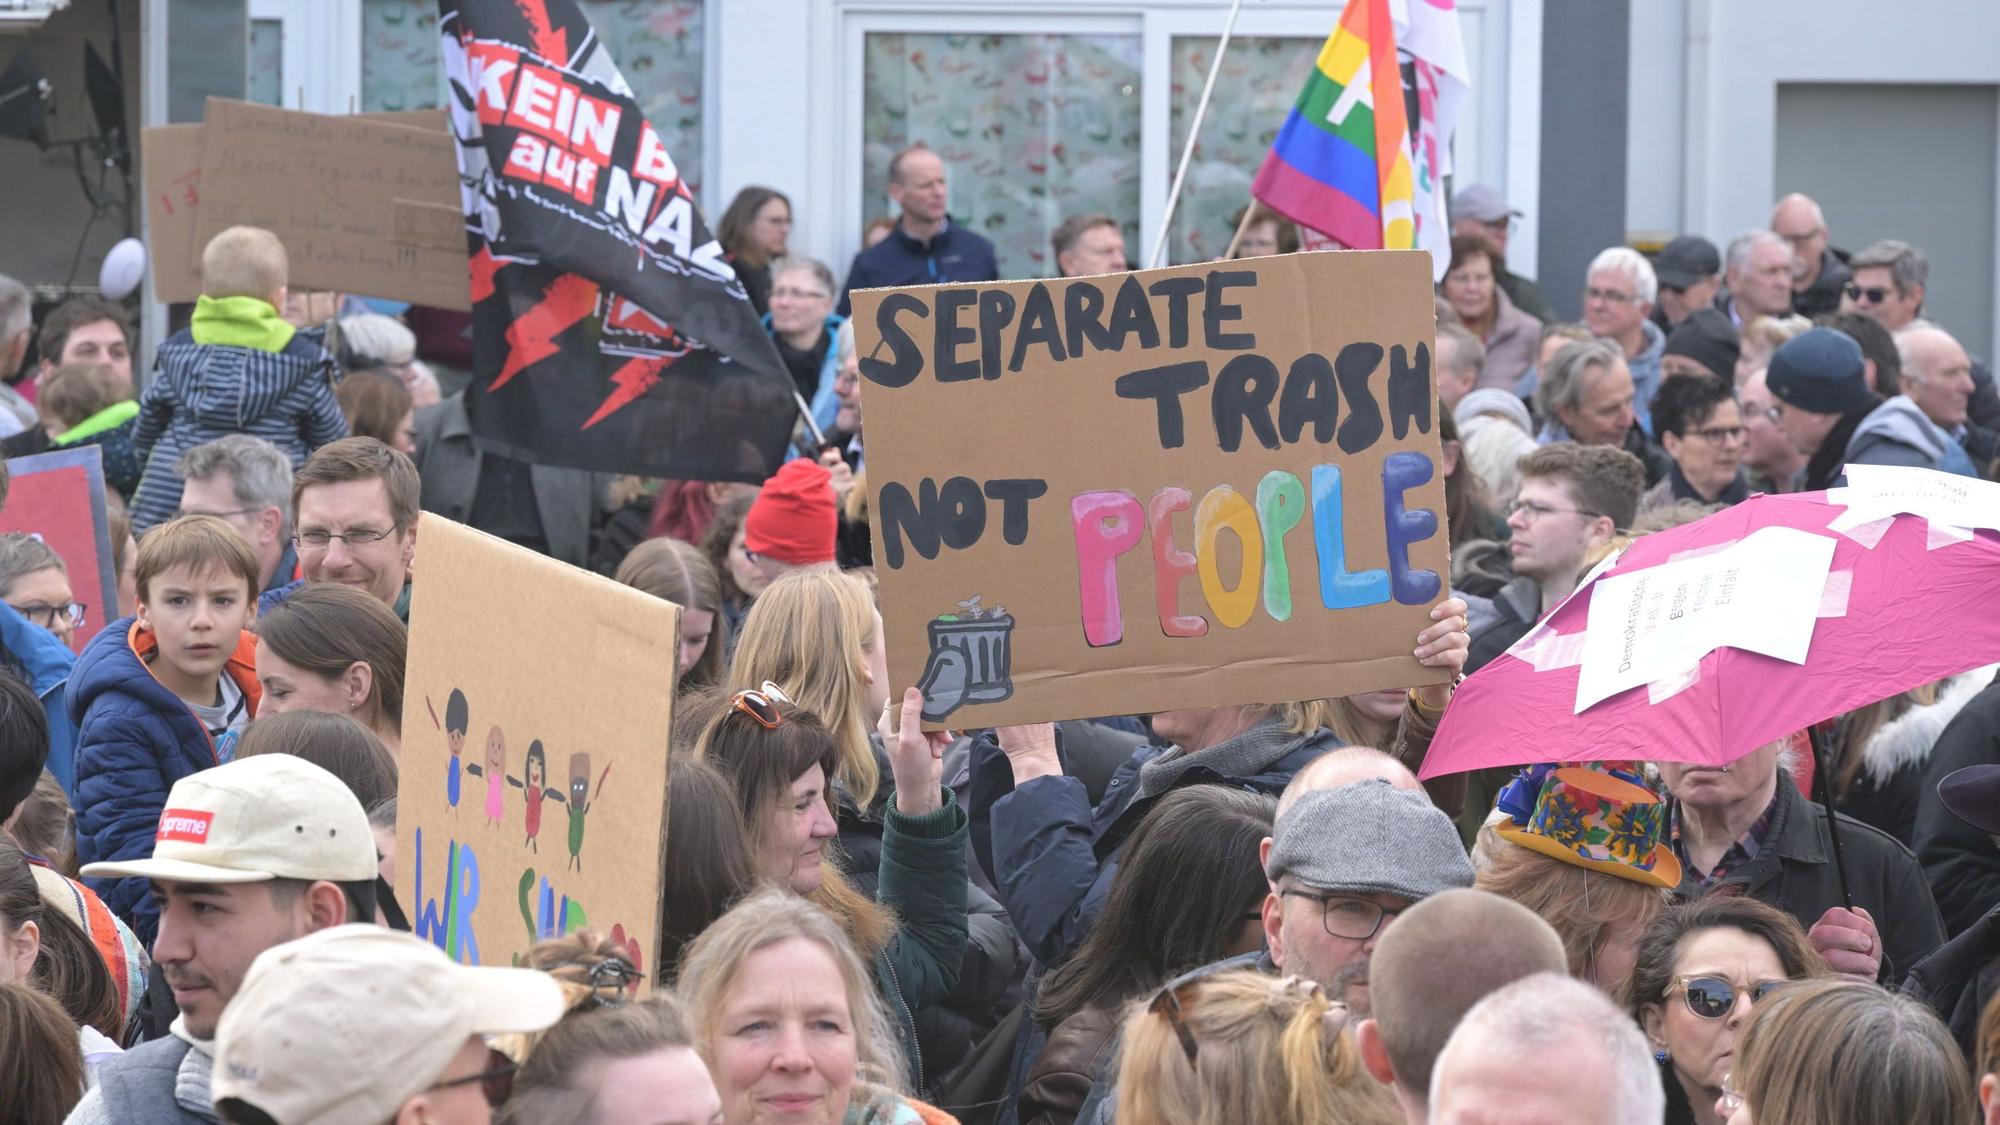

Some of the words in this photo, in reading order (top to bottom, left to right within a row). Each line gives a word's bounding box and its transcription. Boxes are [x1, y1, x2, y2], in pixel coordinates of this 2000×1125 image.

[470, 55, 621, 157] KEIN
[509, 134, 599, 193] auf
[858, 271, 1257, 387] SEPARATE
[1114, 340, 1431, 455] TRASH
[878, 476, 1048, 569] NOT
[1070, 451, 1442, 647] PEOPLE
[1669, 582, 1688, 621] gegen
[1715, 567, 1741, 606] Einfalt
[415, 826, 480, 967] WIR
